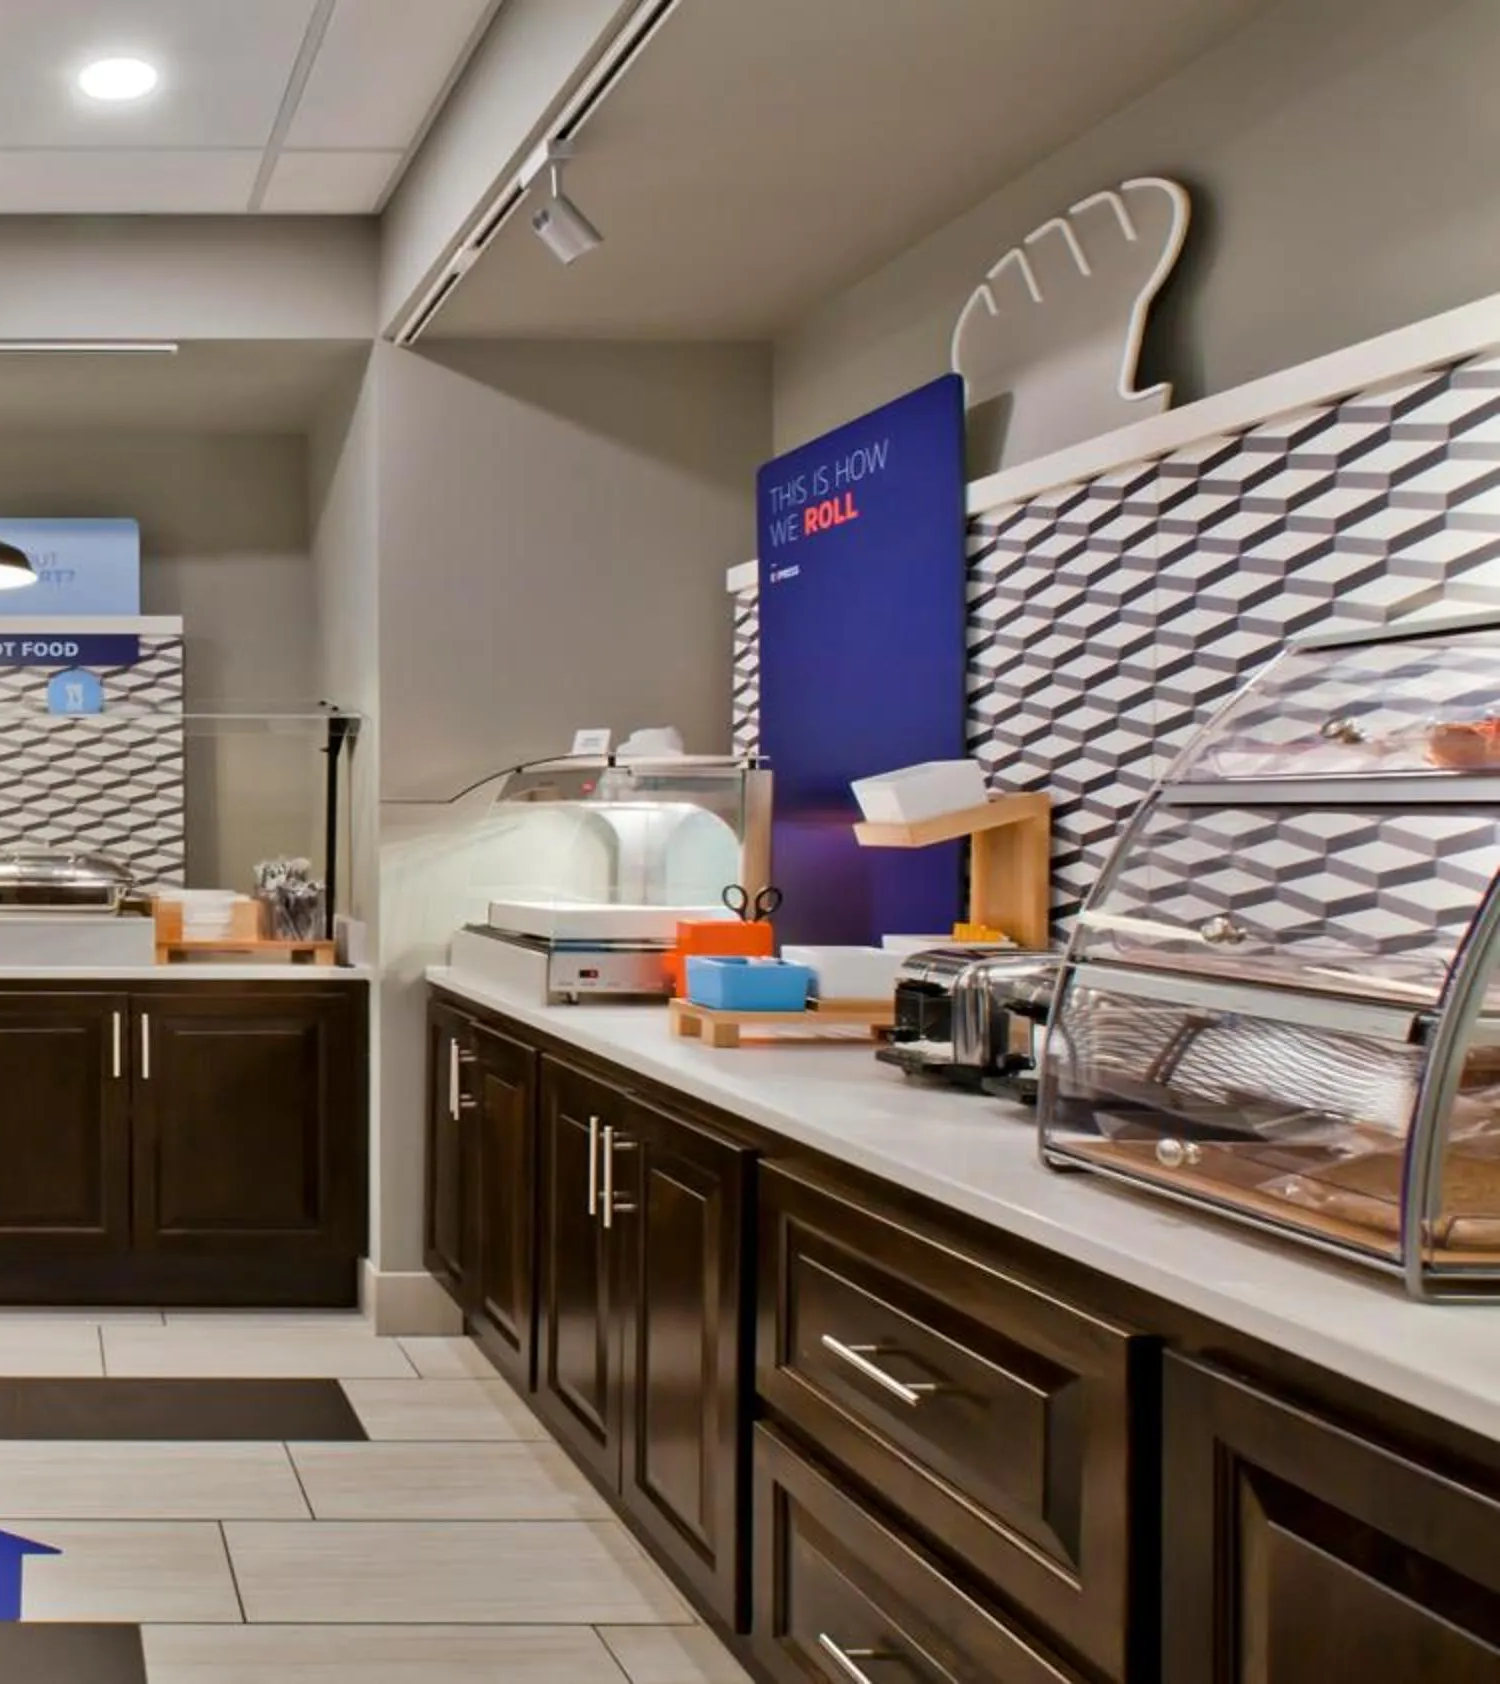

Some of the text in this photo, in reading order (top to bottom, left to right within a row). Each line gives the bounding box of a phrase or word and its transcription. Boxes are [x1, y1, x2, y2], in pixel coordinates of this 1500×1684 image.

[769, 438, 889, 514] THIS IS HOW
[769, 492, 858, 547] WE ROLL
[21, 641, 79, 657] FOOD
